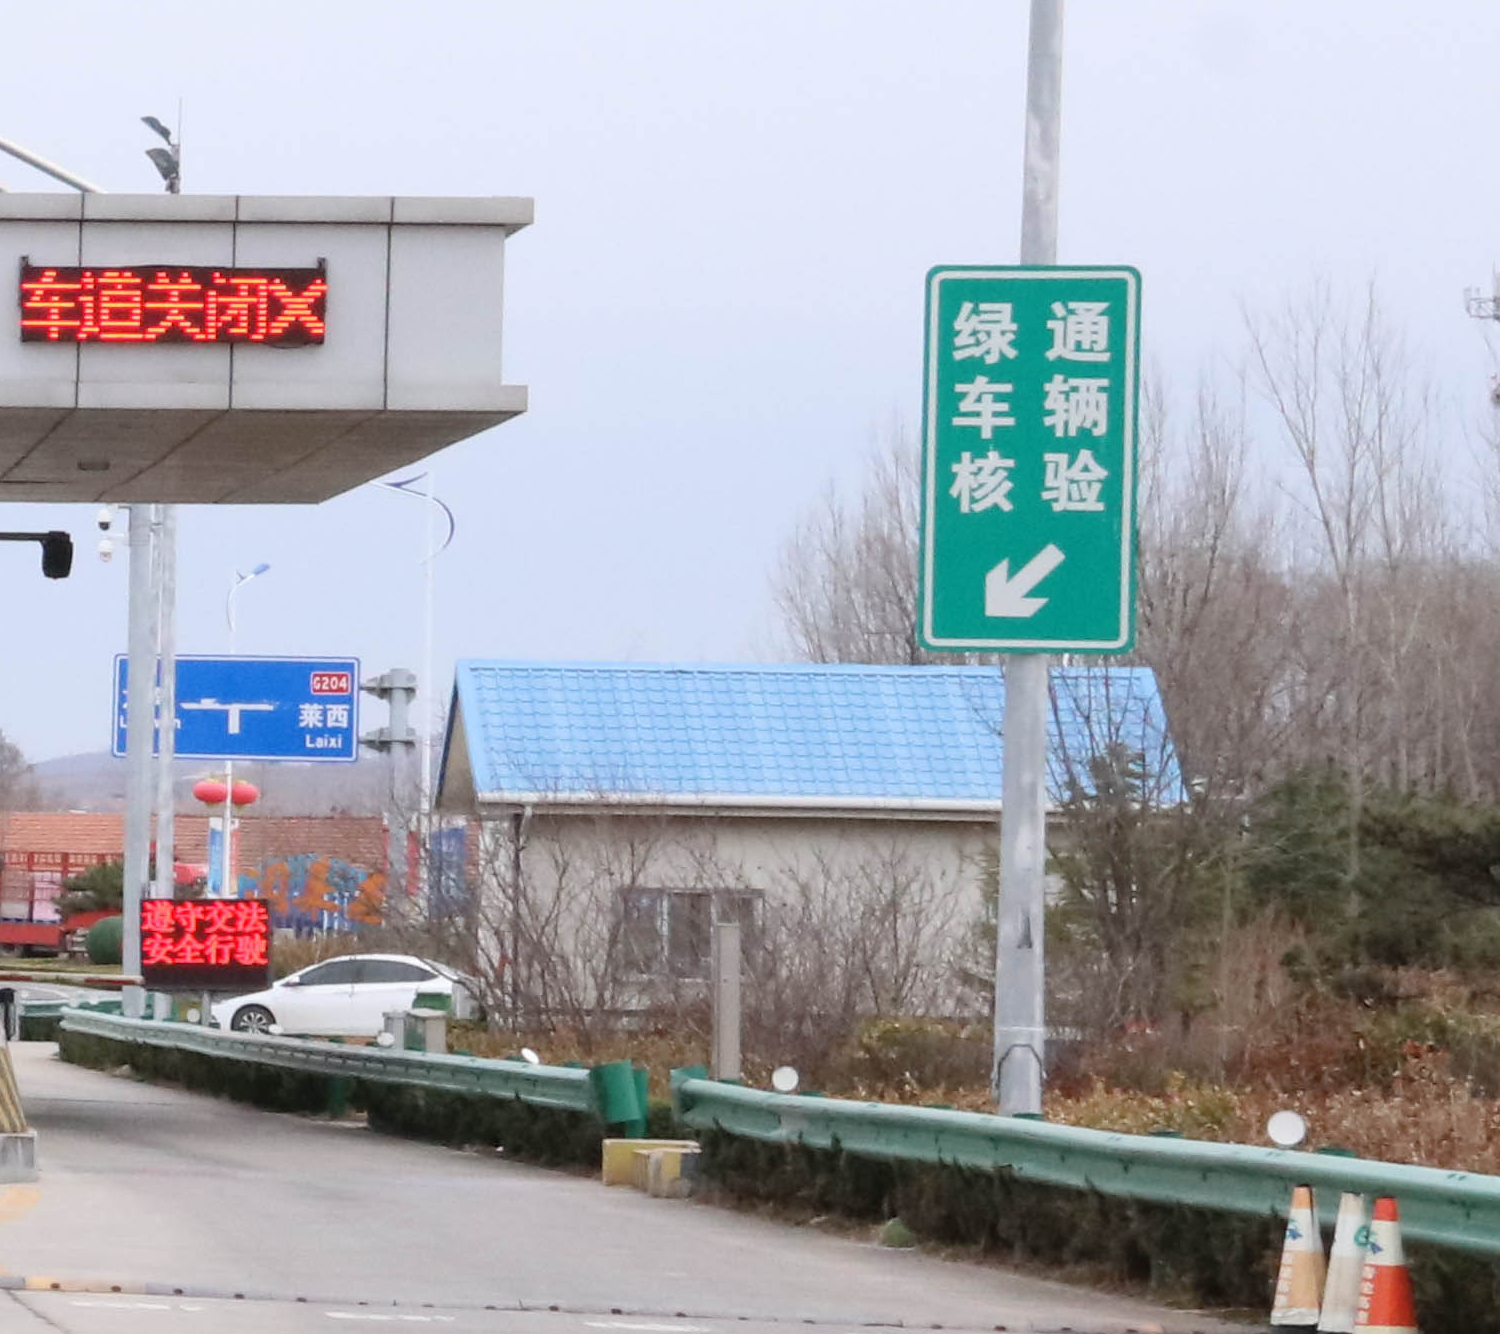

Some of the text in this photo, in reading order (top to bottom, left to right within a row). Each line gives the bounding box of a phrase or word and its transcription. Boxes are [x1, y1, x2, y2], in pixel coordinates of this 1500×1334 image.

[952, 301, 1113, 364] 绿通
[951, 375, 1110, 440] 车辆
[949, 450, 1109, 514] 核验
[312, 676, 349, 690] G204
[298, 703, 351, 730] 莱西
[305, 734, 343, 749] Laixi
[141, 899, 269, 933] 遵守交法
[141, 932, 269, 966] 安全行驶
